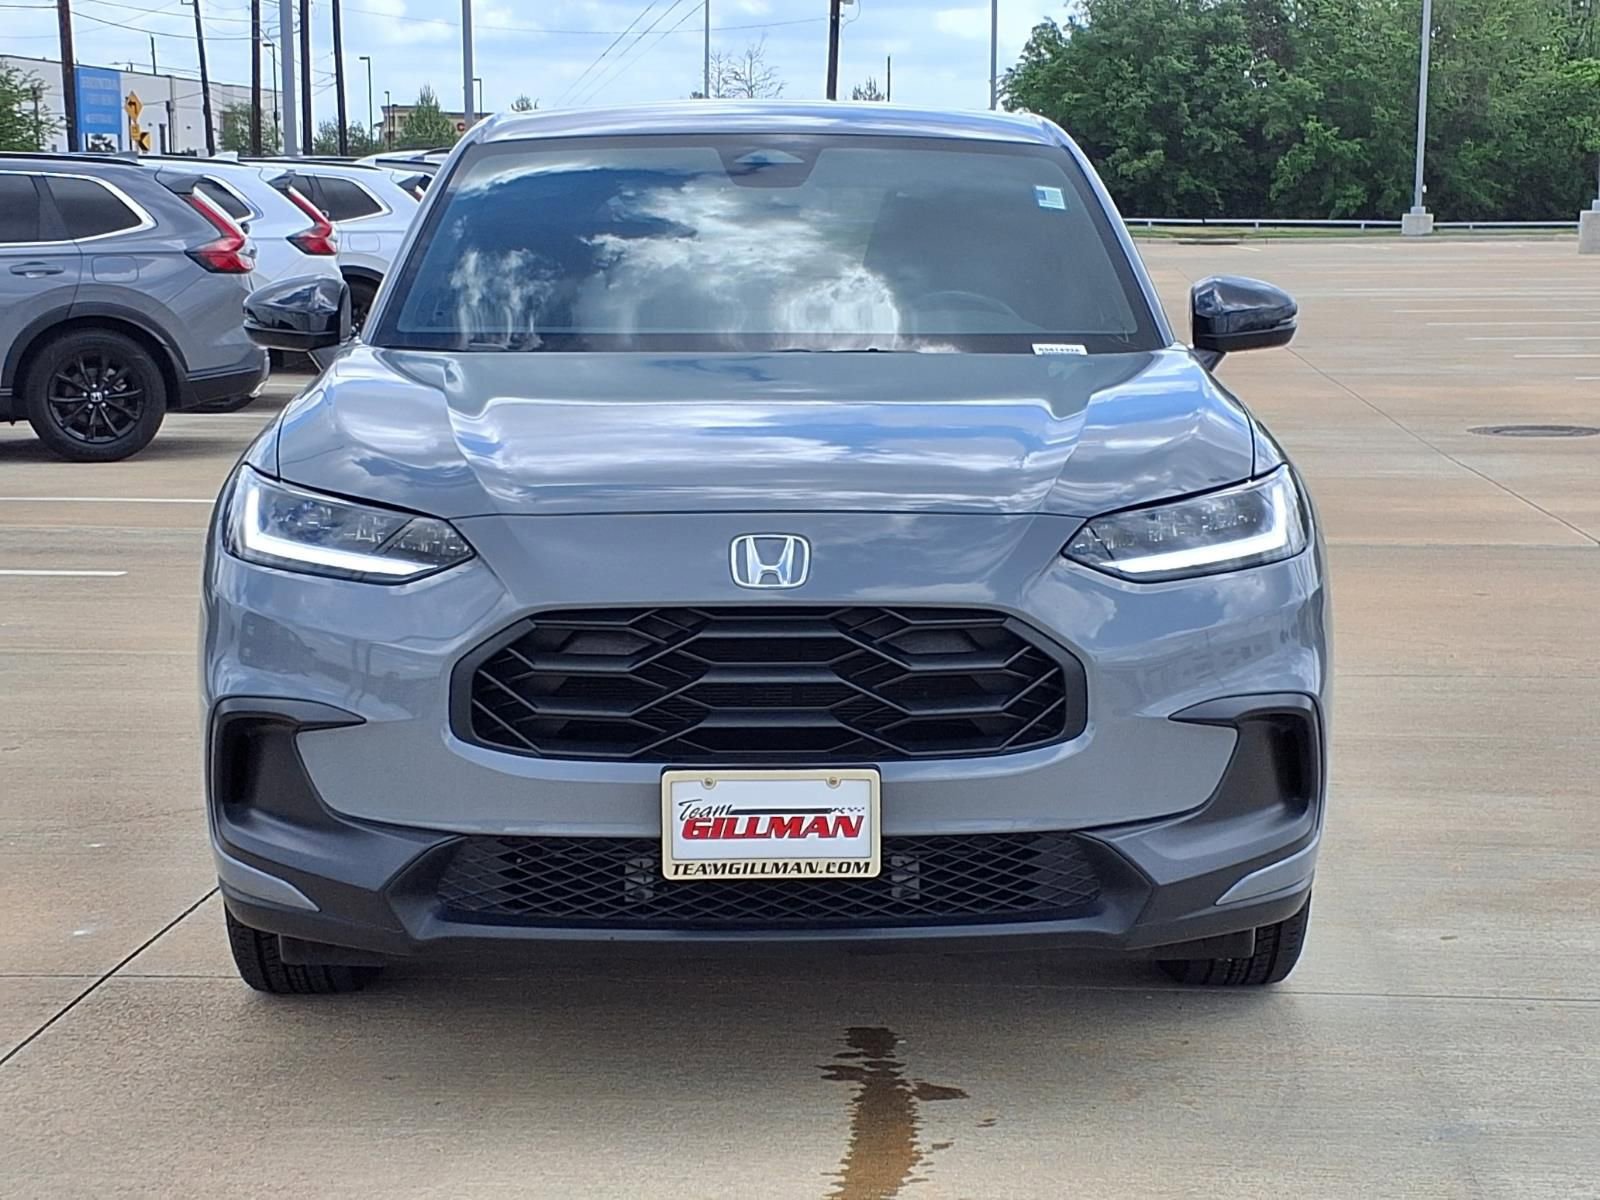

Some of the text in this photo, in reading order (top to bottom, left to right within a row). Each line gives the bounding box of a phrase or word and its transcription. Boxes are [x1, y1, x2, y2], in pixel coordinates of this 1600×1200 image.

[678, 799, 733, 821] Team
[682, 815, 864, 839] GILLMAN
[672, 861, 870, 875] TEAMGILLMAN.COM
